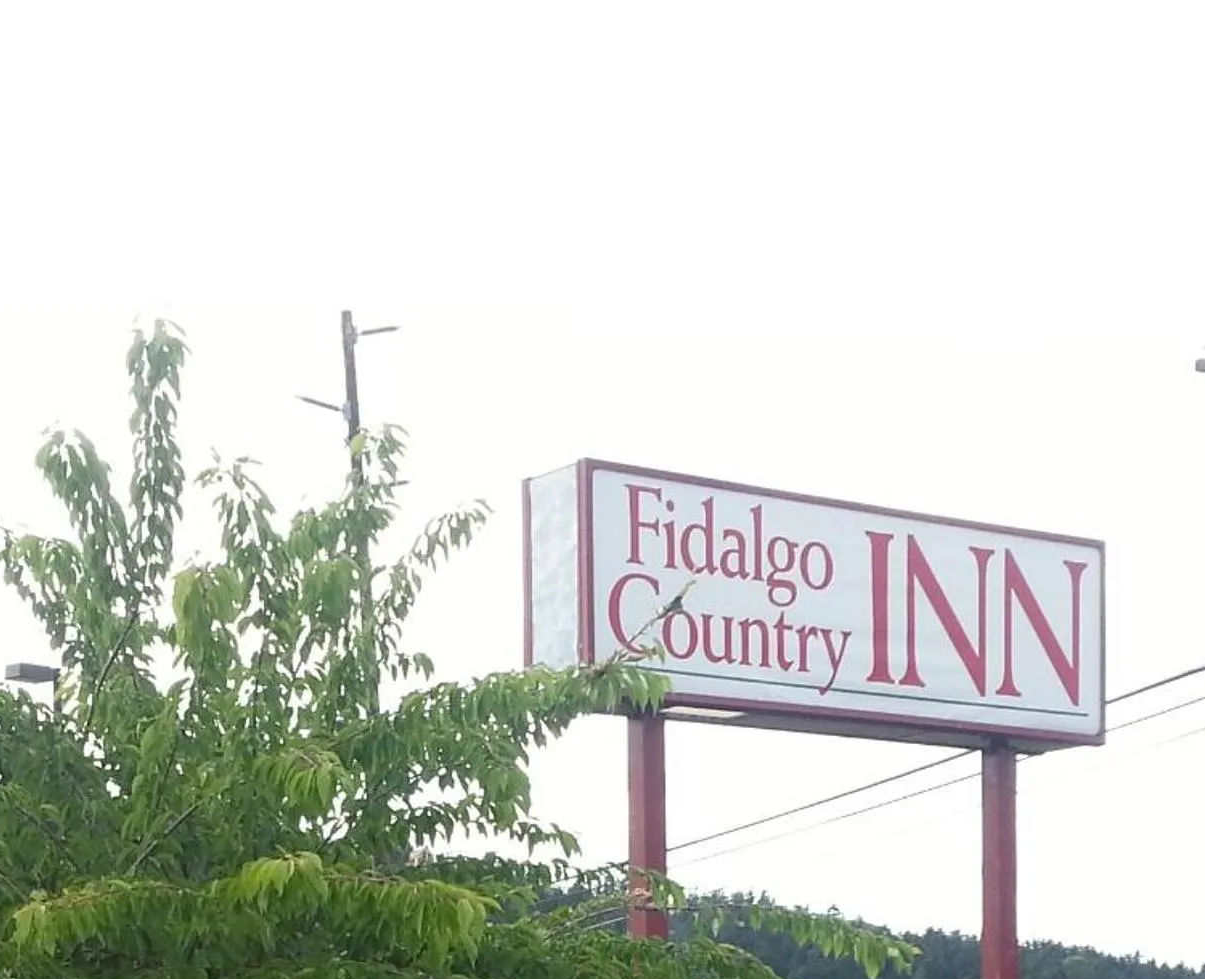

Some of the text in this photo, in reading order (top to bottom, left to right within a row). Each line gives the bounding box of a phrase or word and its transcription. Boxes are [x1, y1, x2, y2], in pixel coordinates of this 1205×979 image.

[624, 483, 834, 607] Fidalgo
[607, 573, 852, 695] Country
[865, 530, 1088, 707] INN
